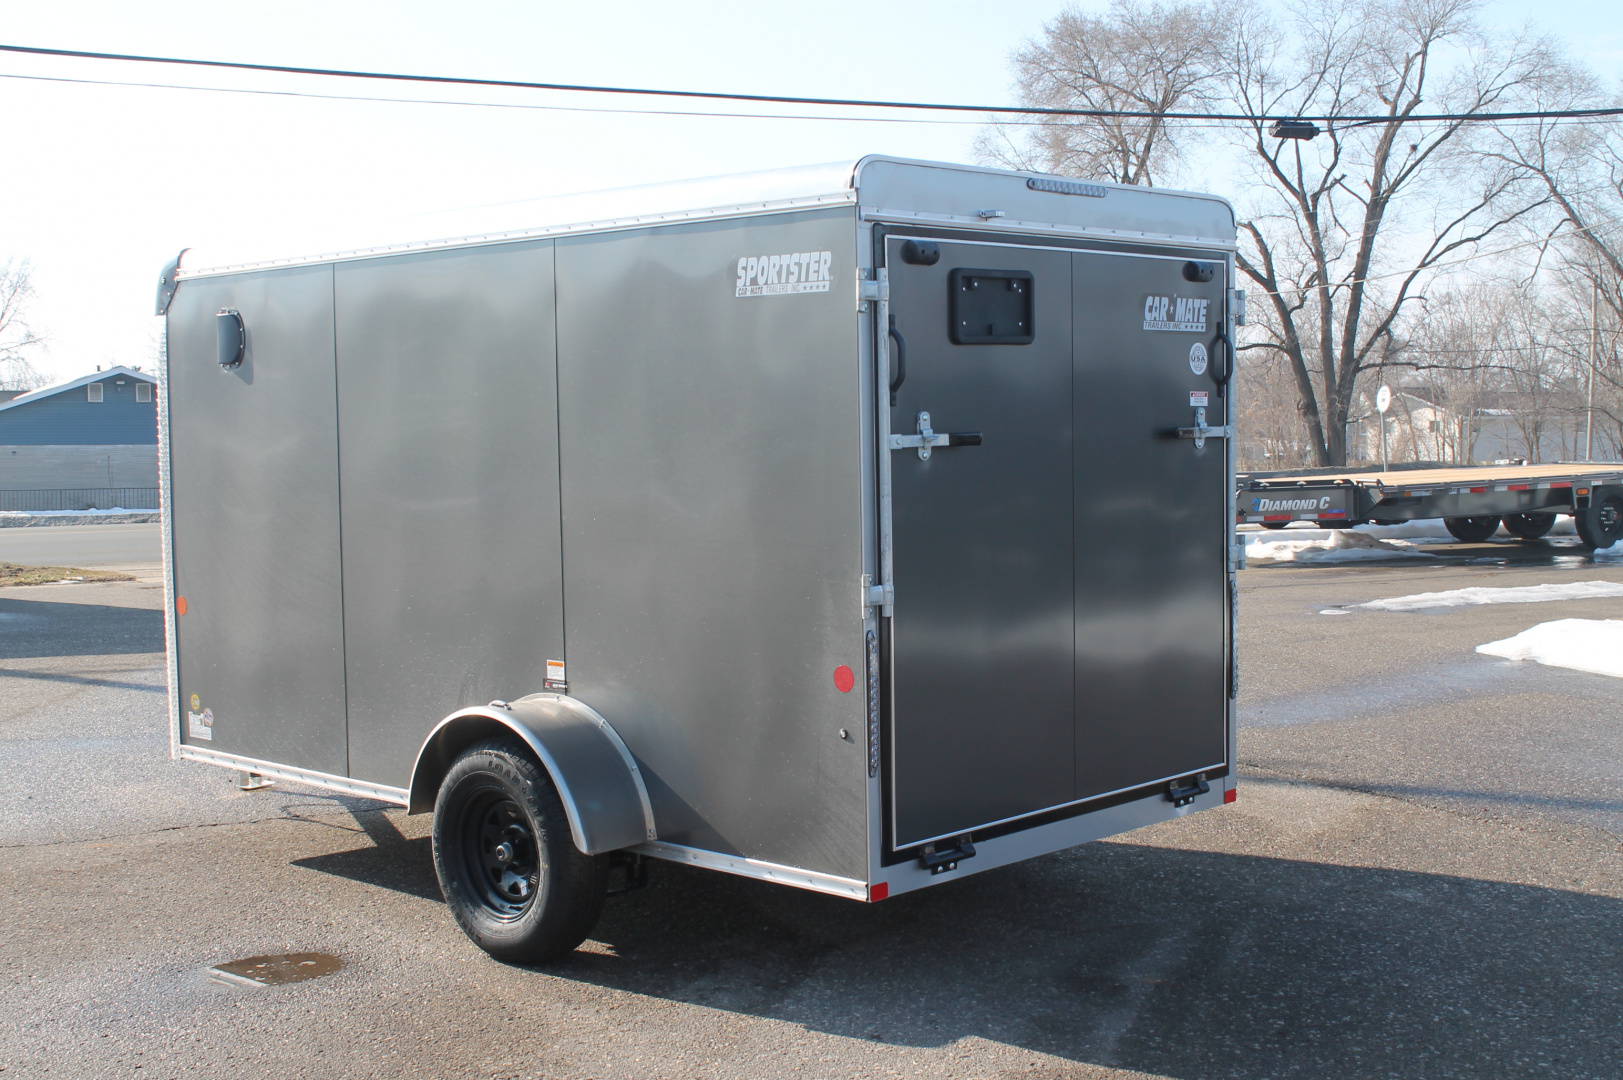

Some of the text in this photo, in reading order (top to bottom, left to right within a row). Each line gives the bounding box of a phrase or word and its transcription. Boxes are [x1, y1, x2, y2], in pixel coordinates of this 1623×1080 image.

[736, 251, 832, 286] SPORTSTER
[1144, 296, 1208, 323] CAR MATE
[1144, 321, 1171, 330] TRAILERS
[1319, 496, 1331, 510] C
[488, 760, 521, 786] LOAD
